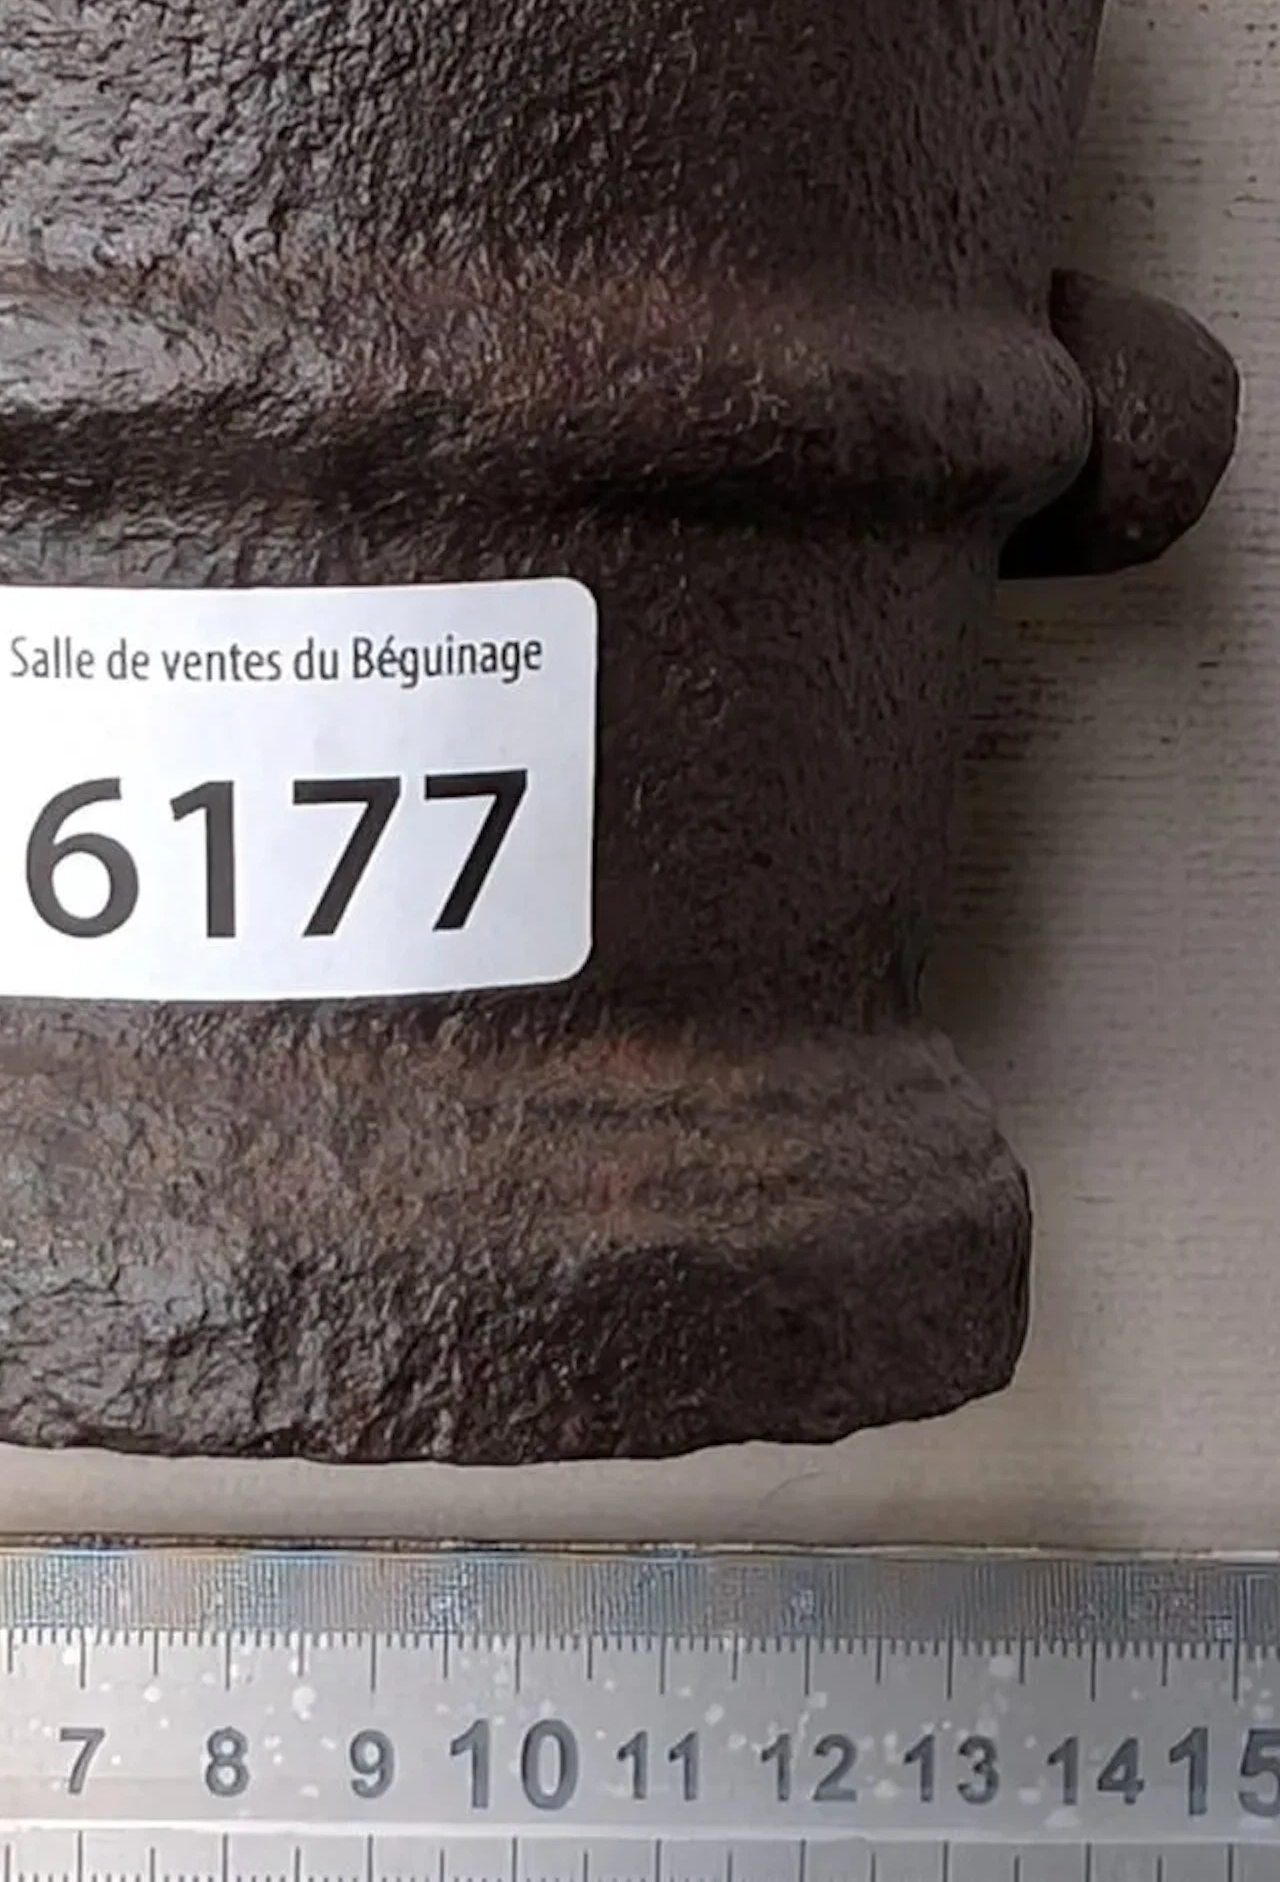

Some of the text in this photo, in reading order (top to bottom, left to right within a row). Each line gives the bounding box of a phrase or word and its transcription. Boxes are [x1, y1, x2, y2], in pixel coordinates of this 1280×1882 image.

[10, 633, 544, 689] Salle de ventes du Béguinage
[24, 767, 529, 939] 6177
[58, 1726, 107, 1797] 7
[204, 1725, 251, 1799] 8
[348, 1728, 395, 1800] 9
[449, 1718, 579, 1811] 10
[616, 1730, 699, 1803] 11
[760, 1733, 857, 1803] 12
[903, 1734, 1000, 1805] 13
[1046, 1736, 1145, 1806] 14
